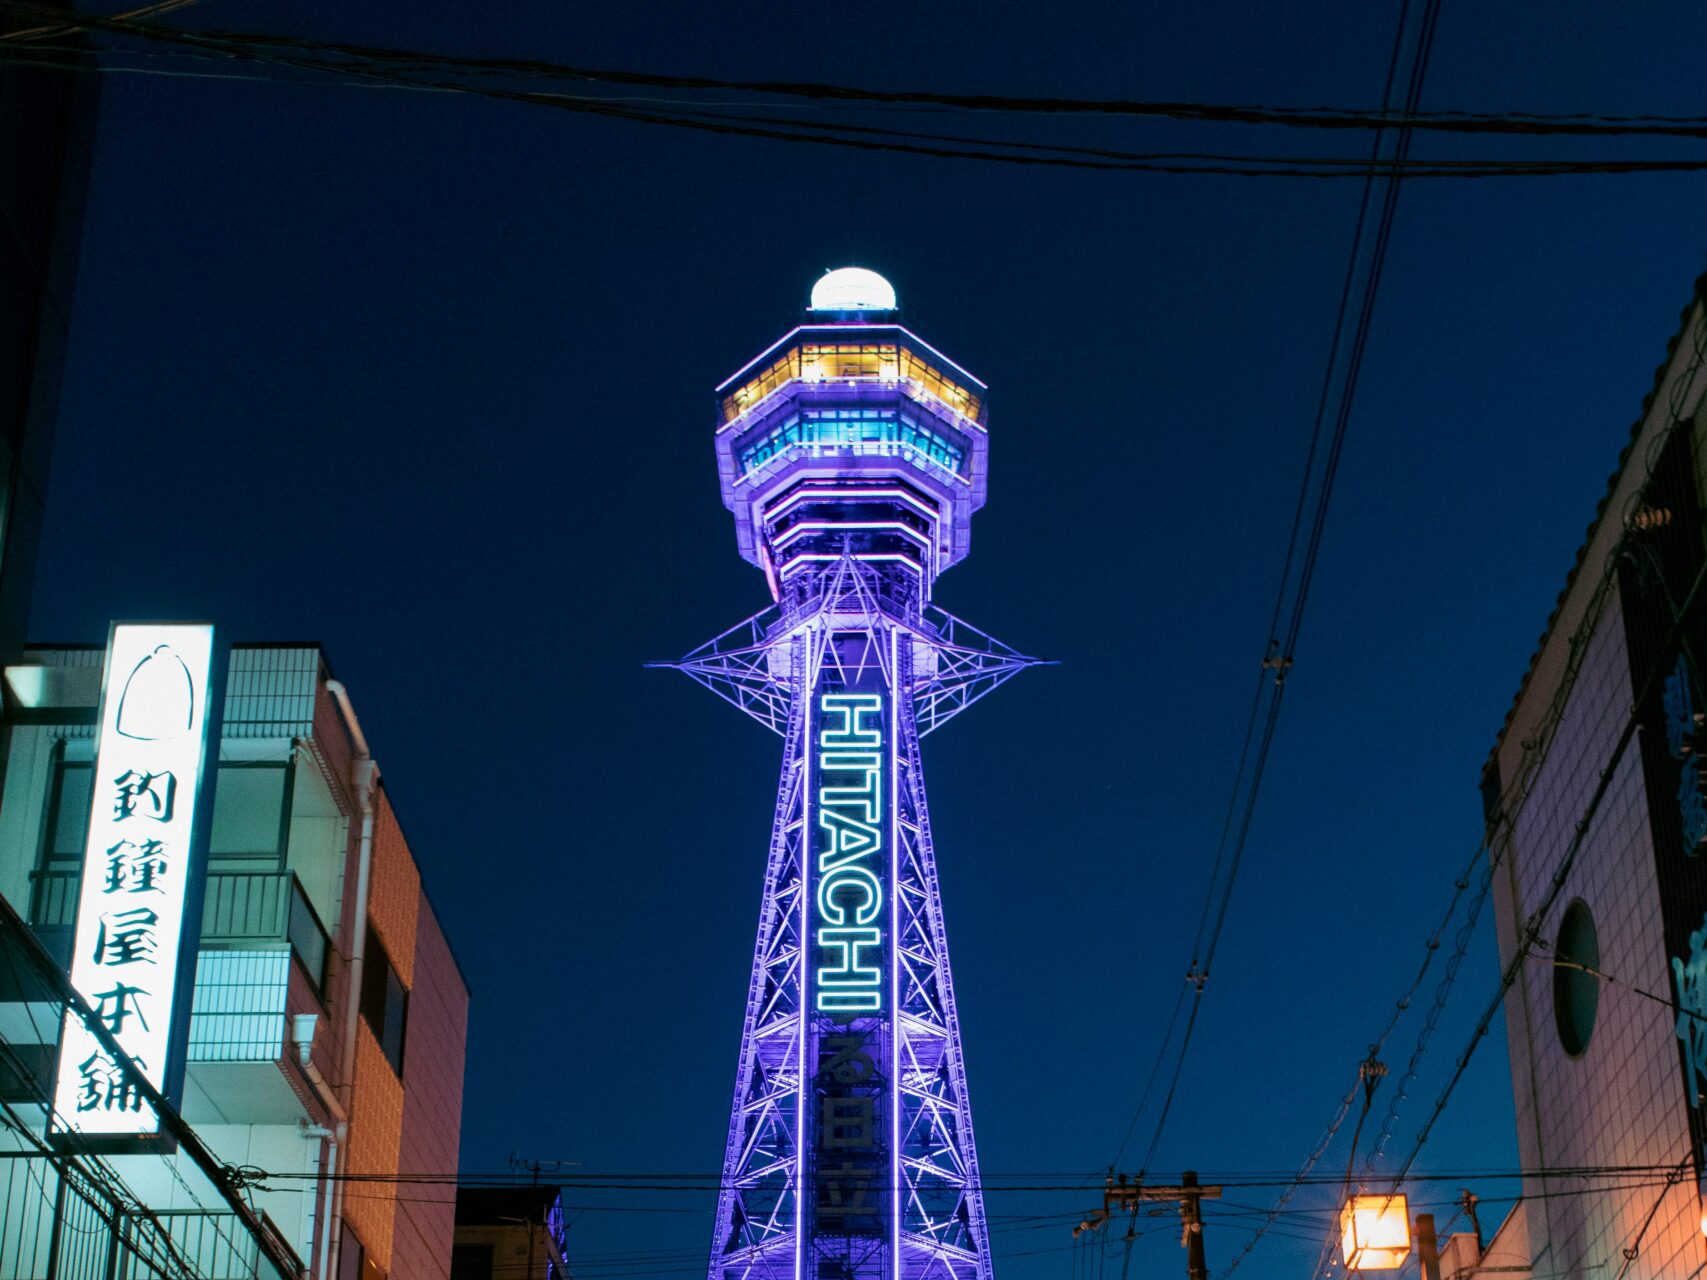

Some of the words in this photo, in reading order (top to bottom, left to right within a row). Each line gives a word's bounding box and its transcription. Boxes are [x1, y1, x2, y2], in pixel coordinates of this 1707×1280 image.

[76, 768, 178, 1114] 釣鐘屋本舗
[816, 692, 883, 1013] HITACHI
